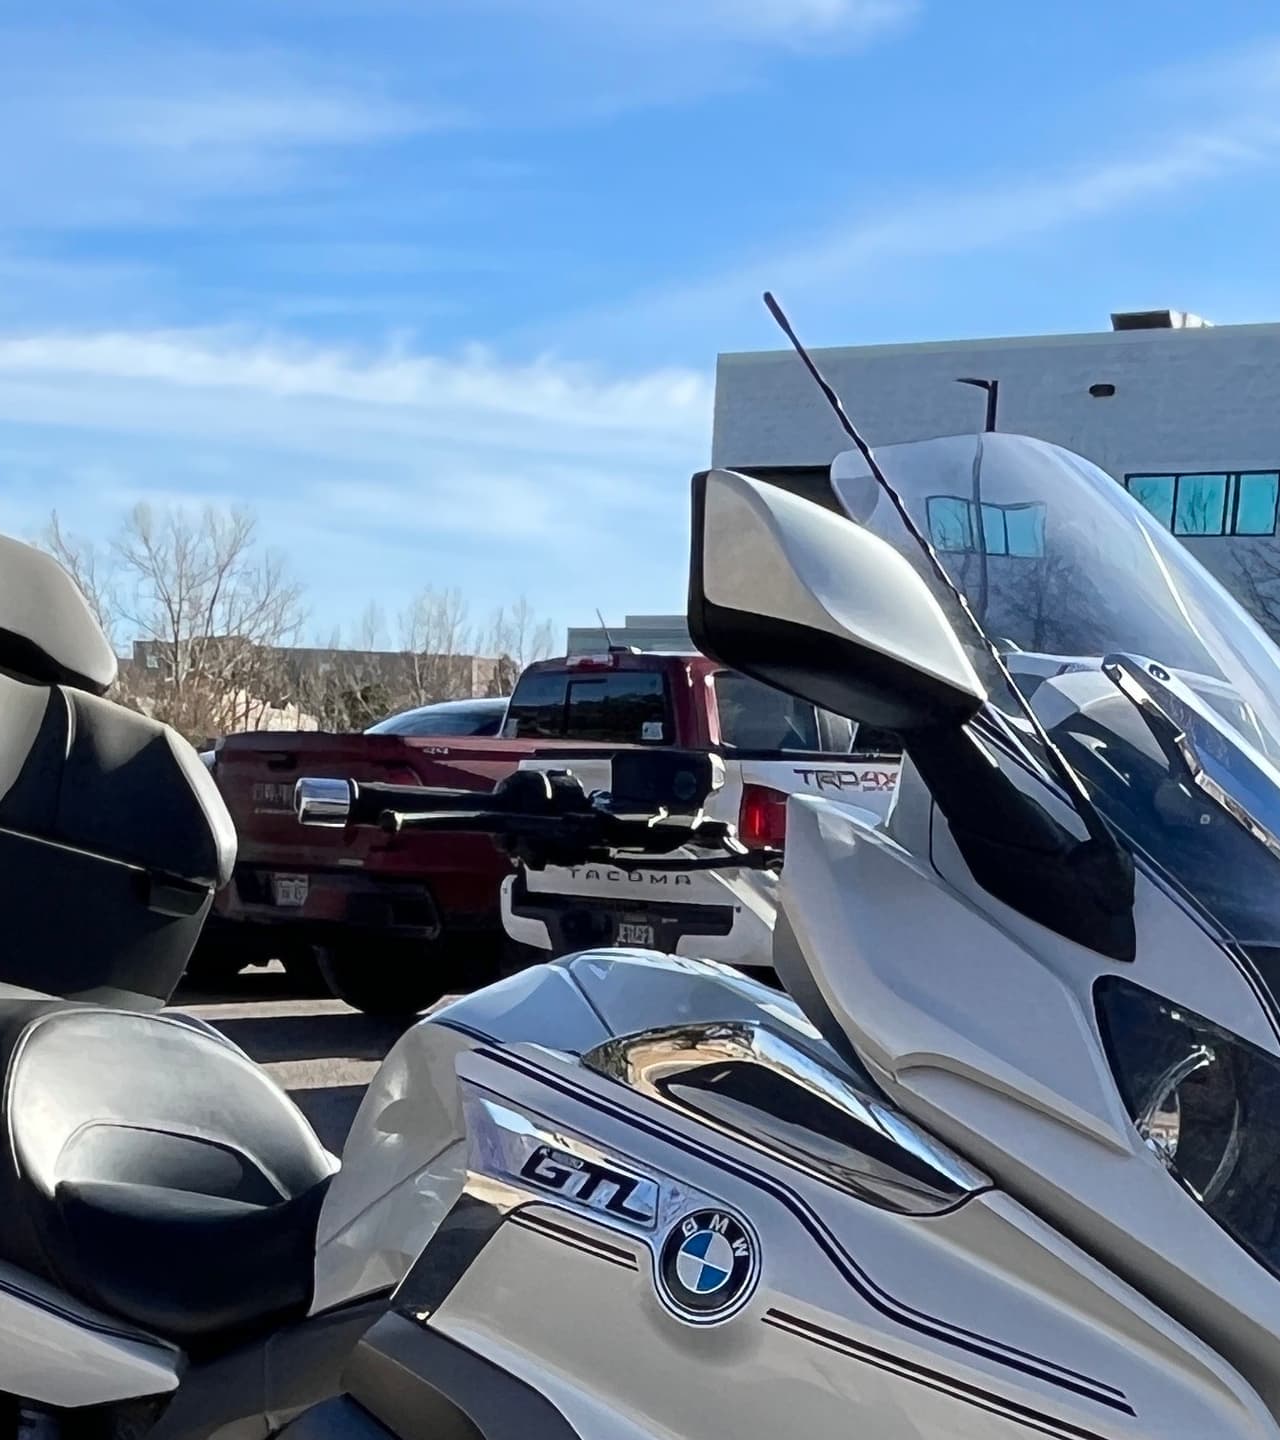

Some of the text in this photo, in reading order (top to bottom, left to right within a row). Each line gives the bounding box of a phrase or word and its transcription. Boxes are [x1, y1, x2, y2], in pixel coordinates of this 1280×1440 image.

[793, 769, 859, 791] TRD
[568, 868, 691, 885] TACOMA
[521, 1145, 655, 1222] GTL
[682, 1213, 749, 1257] BMW
